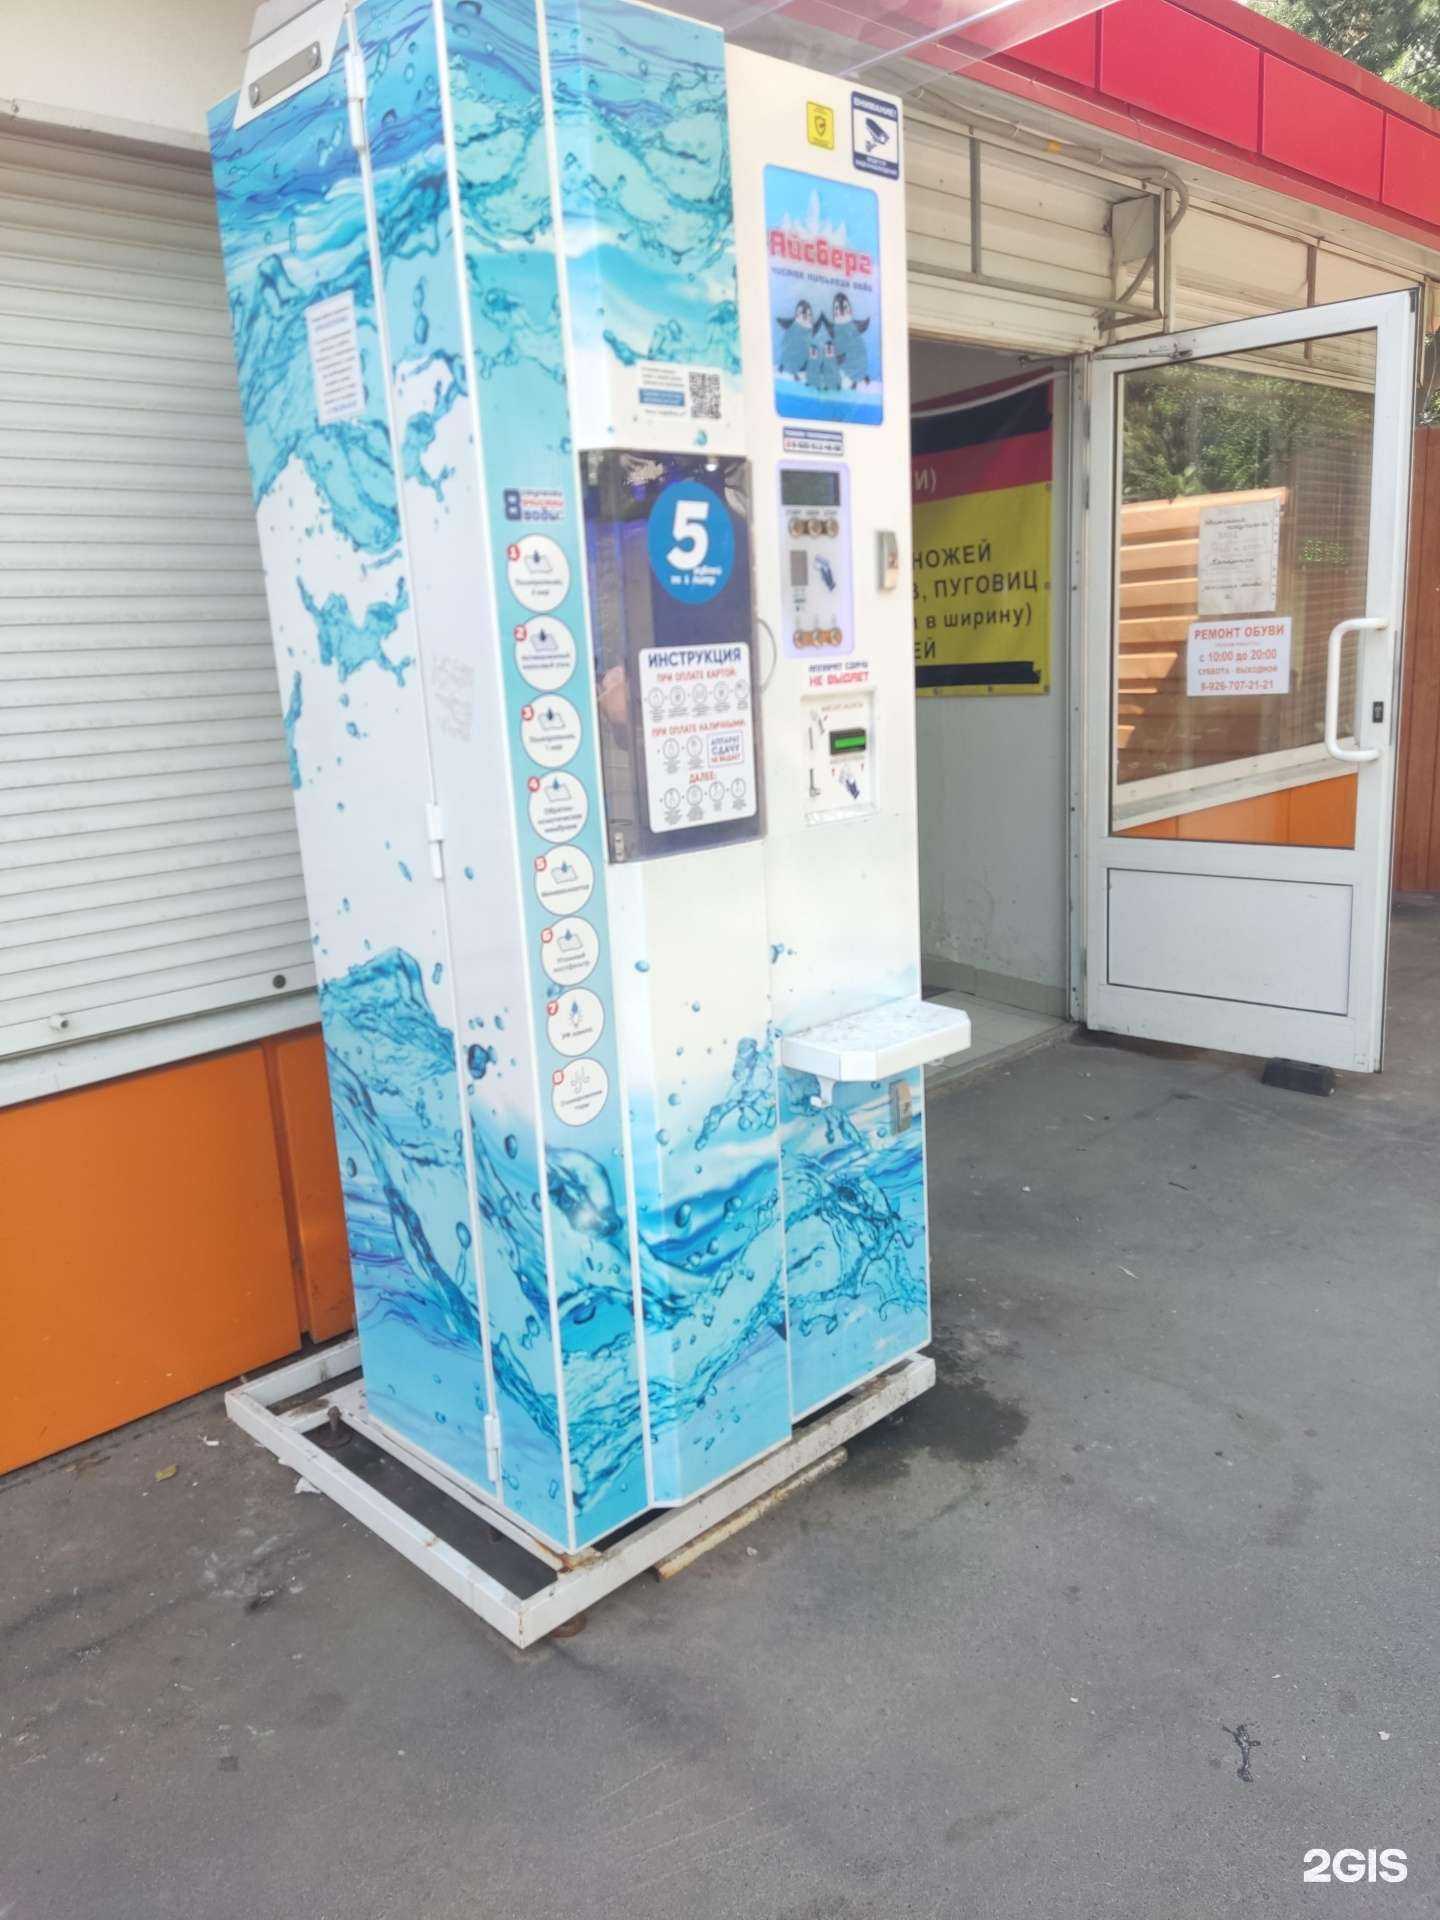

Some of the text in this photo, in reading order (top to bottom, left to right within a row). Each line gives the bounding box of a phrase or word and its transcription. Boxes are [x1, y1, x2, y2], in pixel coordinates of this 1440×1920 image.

[667, 500, 710, 571] 5
[912, 539, 992, 570] НОЖЕЙ
[935, 570, 1039, 599] ПУГОВИЦ
[926, 616, 937, 629] в
[944, 602, 1033, 630] ширину)
[1194, 624, 1285, 640] РЕМОНТ ОБУВИ
[648, 647, 742, 668] ИНСТРУКЦИЯ
[657, 672, 673, 682] ПРИ
[675, 669, 704, 681] ОПЛАТЕ
[809, 675, 823, 688] НЕ
[651, 726, 667, 737] ПРИ
[669, 723, 697, 735] ОПЛАТЕ
